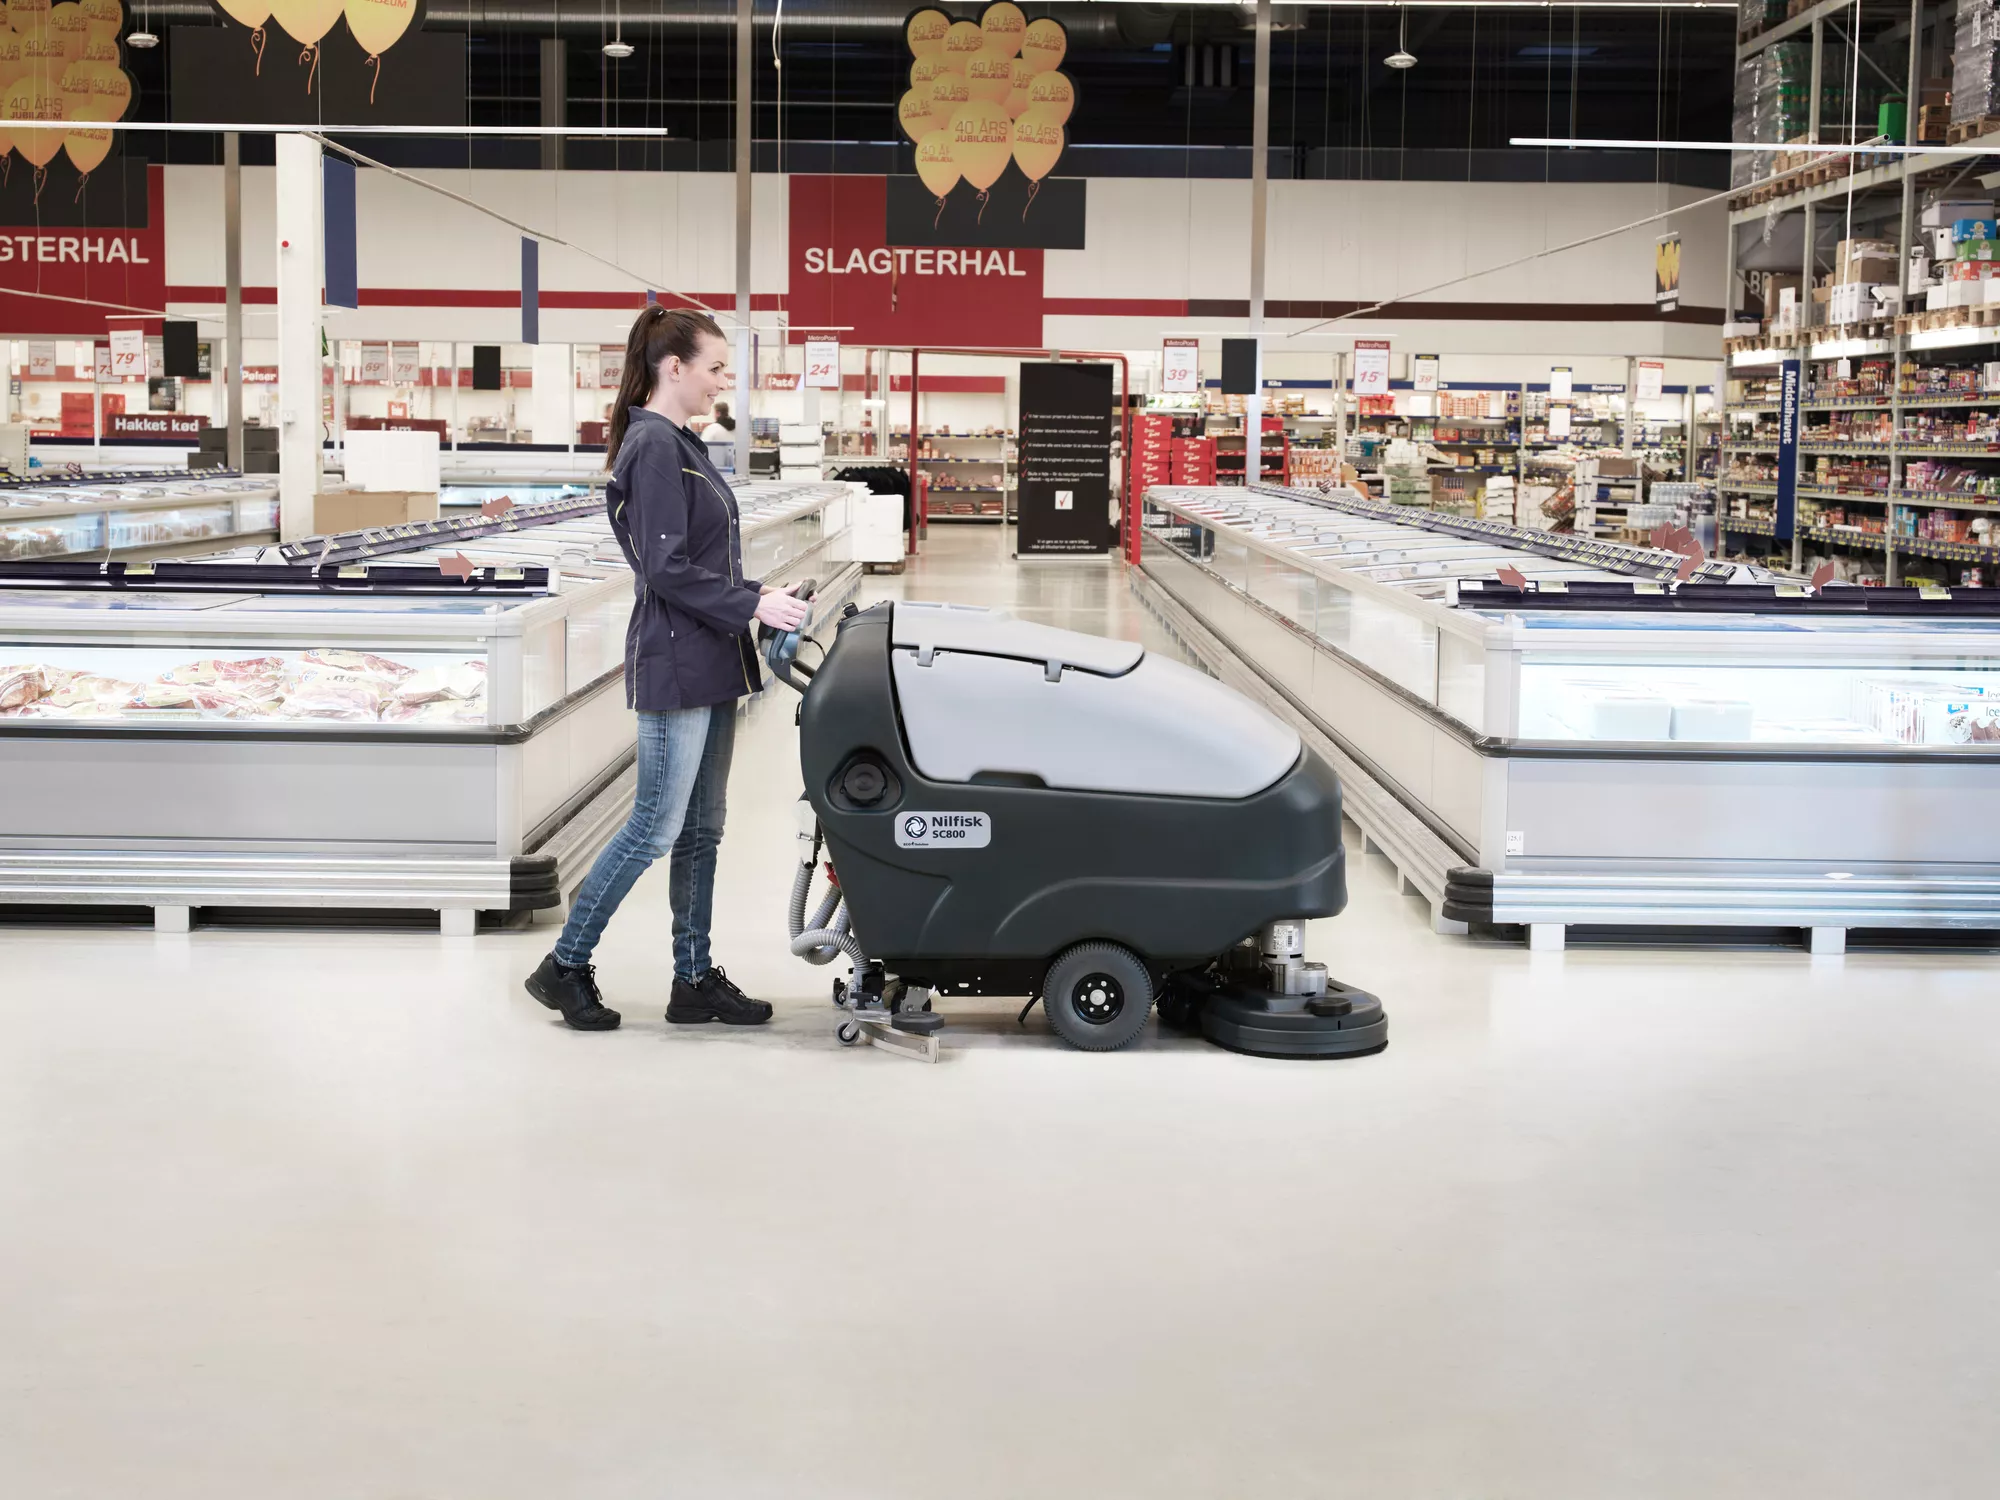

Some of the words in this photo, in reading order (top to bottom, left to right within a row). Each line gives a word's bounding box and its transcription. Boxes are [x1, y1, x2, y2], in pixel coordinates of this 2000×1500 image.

[84, 3, 96, 13] 40
[99, 3, 119, 15] ÅRS
[51, 16, 63, 27] 40
[68, 15, 87, 26] ÅRS
[985, 17, 998, 27] 40
[1002, 15, 1023, 27] ÅRS
[912, 25, 924, 36] 40
[928, 22, 949, 34] ÅRS
[25, 40, 38, 51] 40
[42, 38, 65, 51] ÅRS
[947, 36, 960, 47] 40
[963, 34, 983, 46] ÅRS
[1026, 32, 1040, 42] 40
[1043, 32, 1065, 46] ÅRS
[1025, 42, 1061, 51] JUBILÆUM
[915, 65, 929, 77] 40
[970, 62, 985, 74] 40
[988, 60, 1010, 73] ÅRS
[933, 86, 946, 96] 40
[949, 84, 970, 97] ÅRS
[1031, 86, 1045, 96] 40
[1048, 83, 1069, 97] ÅRS
[10, 97, 29, 111] 40
[35, 94, 63, 111] ÅRS
[903, 102, 917, 113] 40
[10, 112, 62, 120] JUBILÆUM
[954, 121, 974, 135] 40
[978, 118, 1008, 135] ÅRS
[1016, 124, 1032, 136] 40
[1036, 123, 1060, 139] ÅRS
[954, 135, 1007, 143] JUBILÆUM
[1015, 135, 1058, 145] JUBILÆUM
[920, 145, 935, 156] 40
[804, 247, 1027, 276] SLAGTERHAL
[115, 352, 136, 365] 79
[242, 371, 277, 382] Pølser
[809, 364, 830, 376] 24
[1167, 368, 1188, 381] 39
[1360, 370, 1380, 383] 15
[767, 376, 796, 388] Paté
[1783, 370, 1797, 445] Middelhavet
[115, 418, 168, 432] Hakket
[171, 419, 199, 432] kød
[931, 816, 983, 827] Nilfisk
[932, 830, 966, 839] SC800
